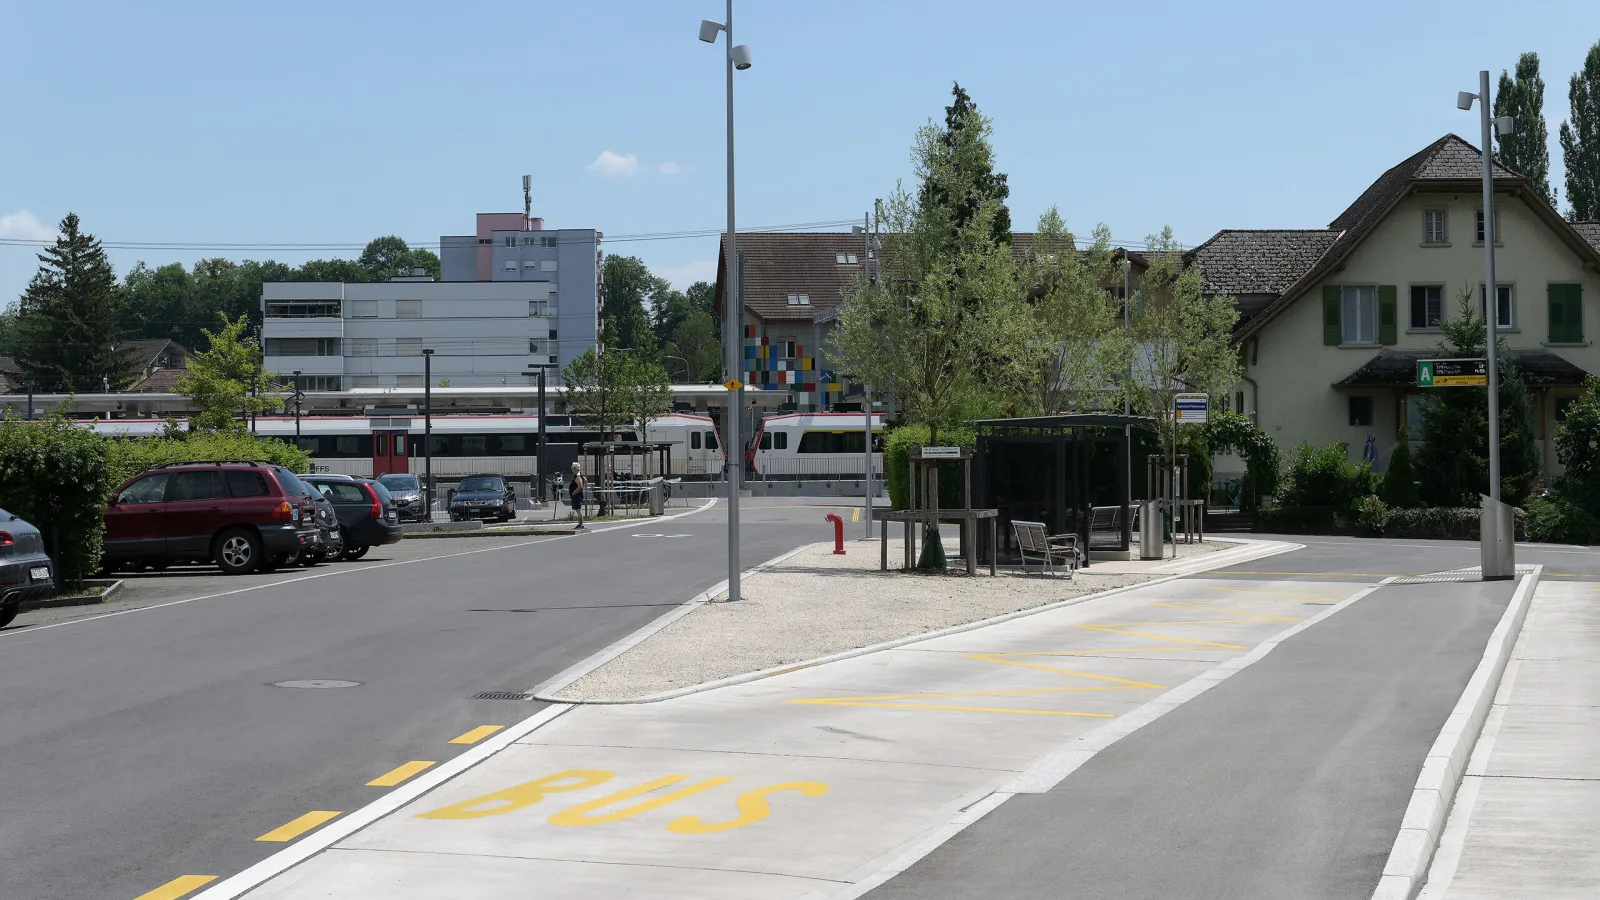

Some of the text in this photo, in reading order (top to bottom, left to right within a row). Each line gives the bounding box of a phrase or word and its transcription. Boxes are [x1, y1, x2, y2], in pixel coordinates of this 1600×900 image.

[1421, 367, 1431, 382] A
[315, 465, 330, 473] FFS
[411, 768, 829, 834] BUS
